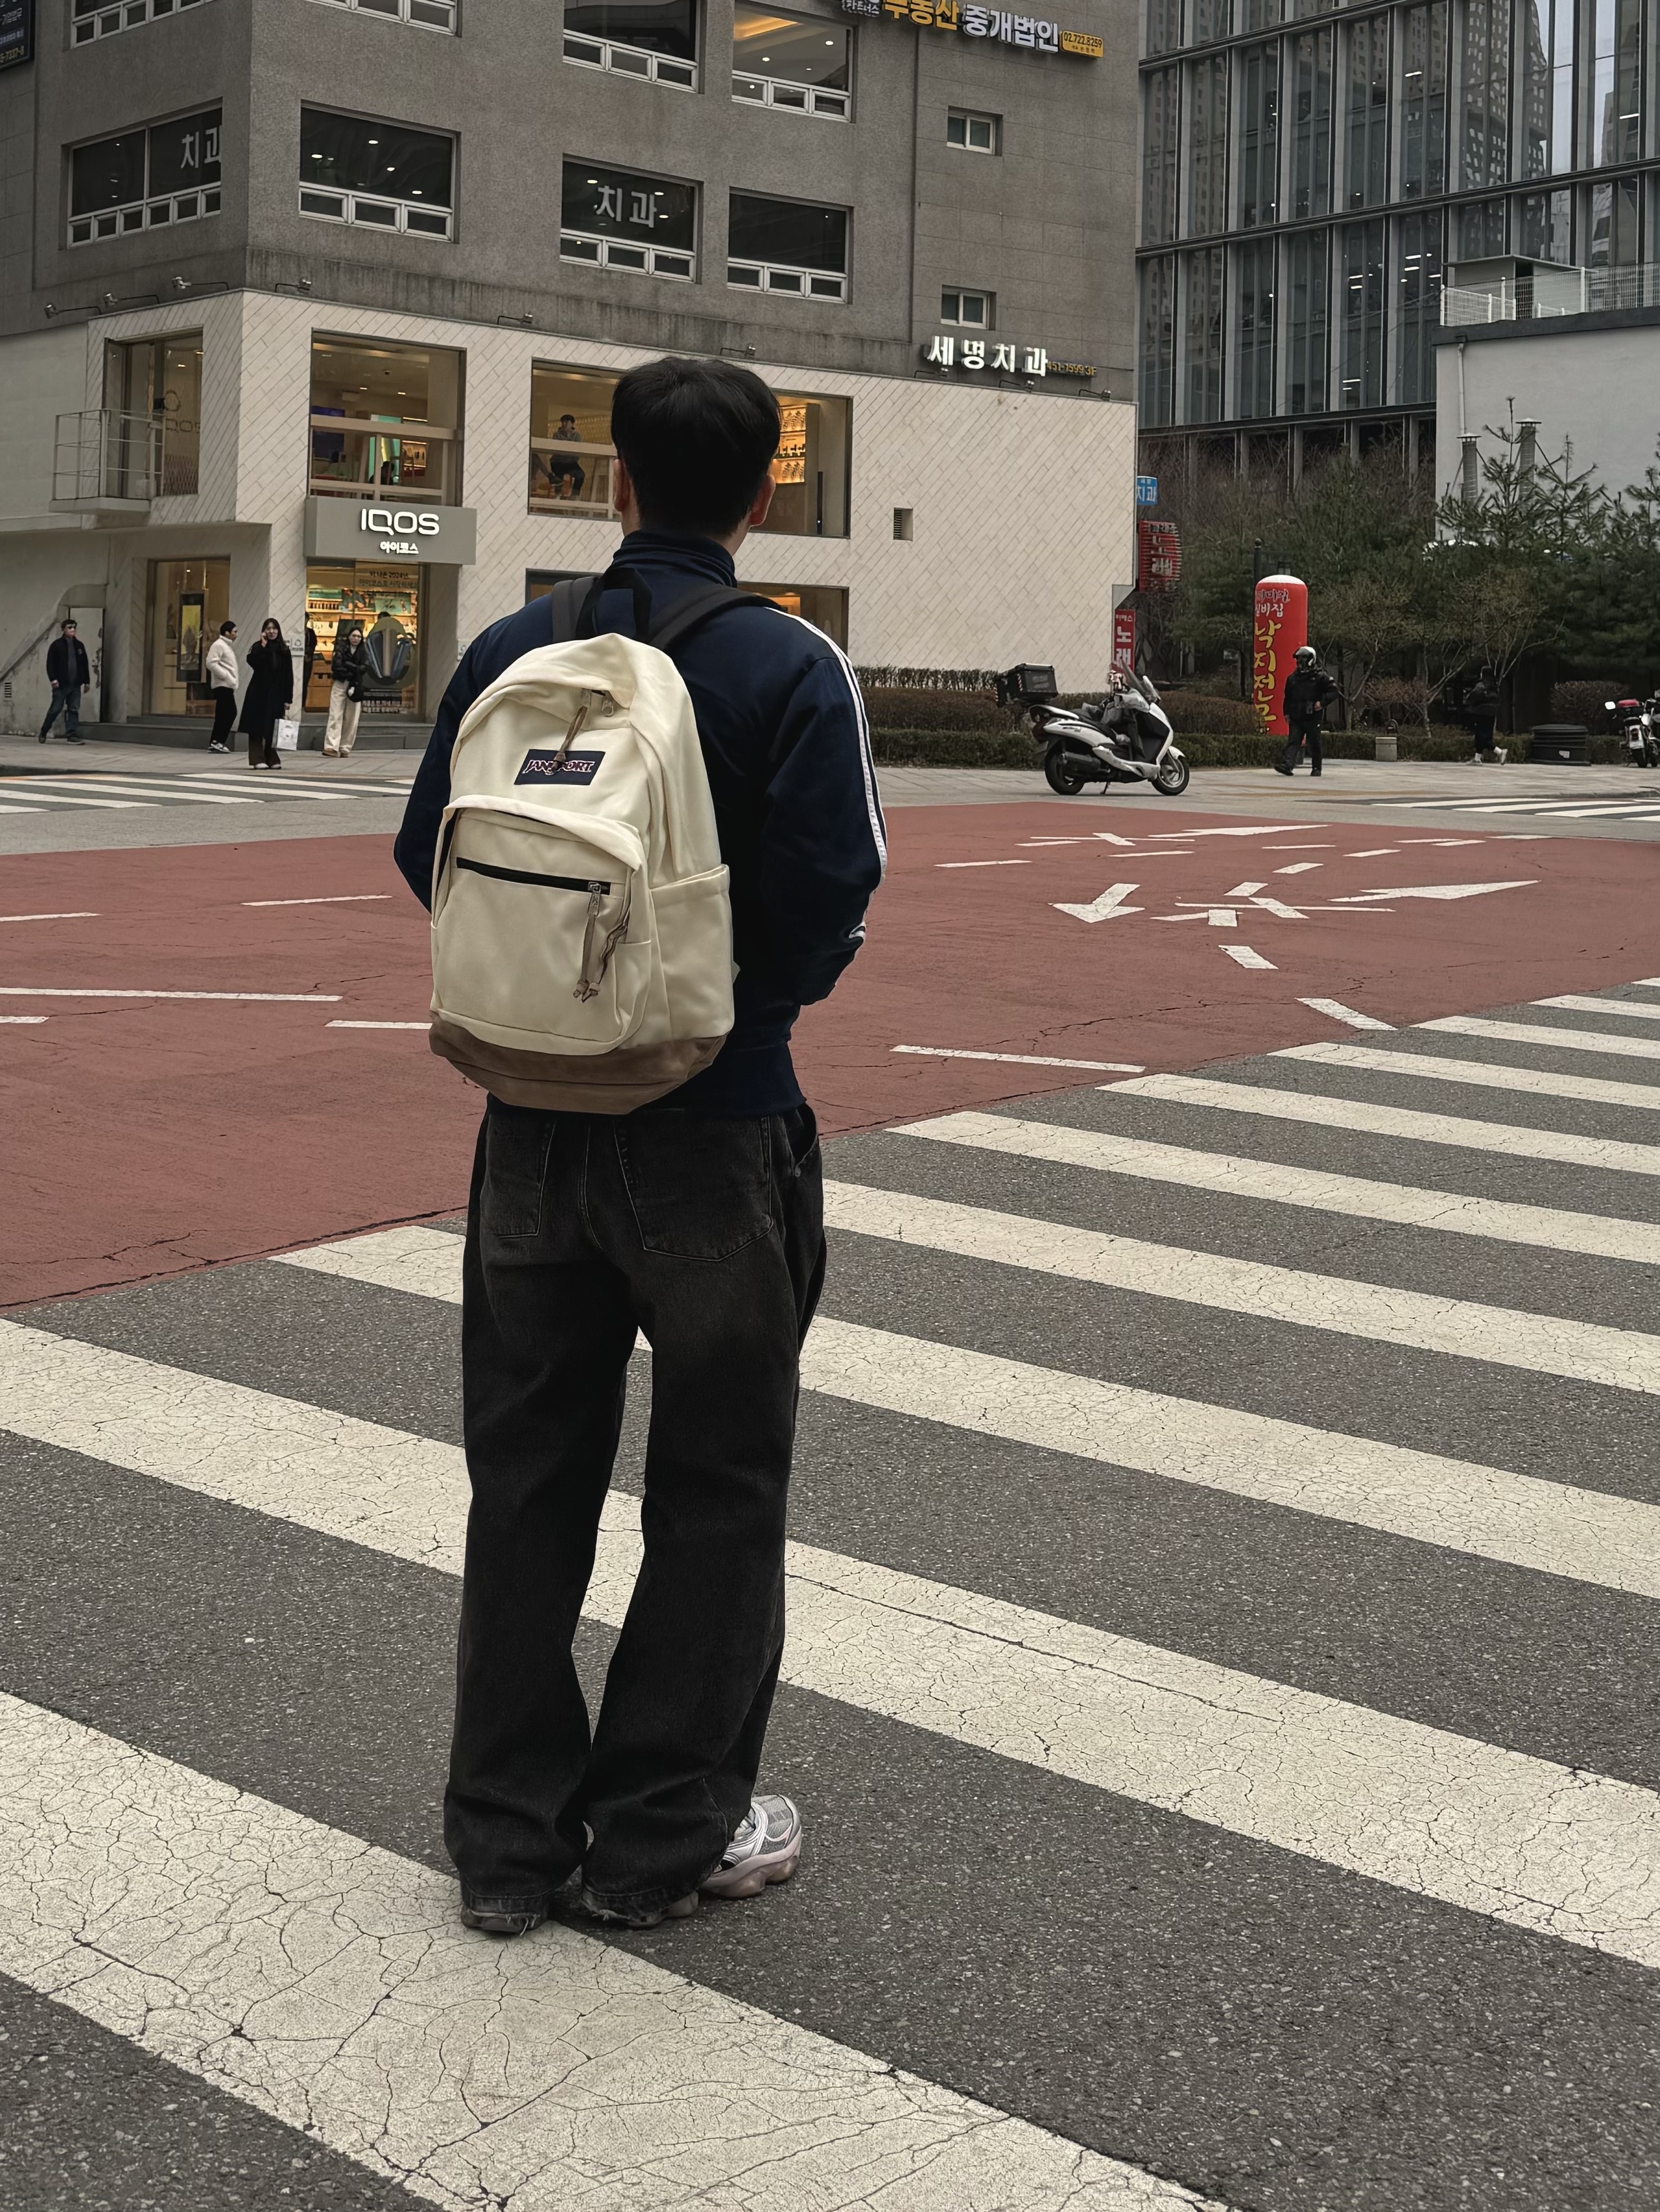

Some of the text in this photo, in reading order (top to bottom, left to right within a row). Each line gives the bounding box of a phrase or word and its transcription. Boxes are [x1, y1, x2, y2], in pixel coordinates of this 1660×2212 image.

[883, 0, 1058, 53] 부동산 중개법인
[180, 124, 221, 169] 치과
[596, 186, 657, 228] 치과
[927, 335, 1047, 376] 세명치과
[1137, 486, 1157, 502] 치과
[361, 508, 440, 535] IQOS
[1116, 626, 1131, 667] 노래
[522, 760, 595, 775] JANORT
